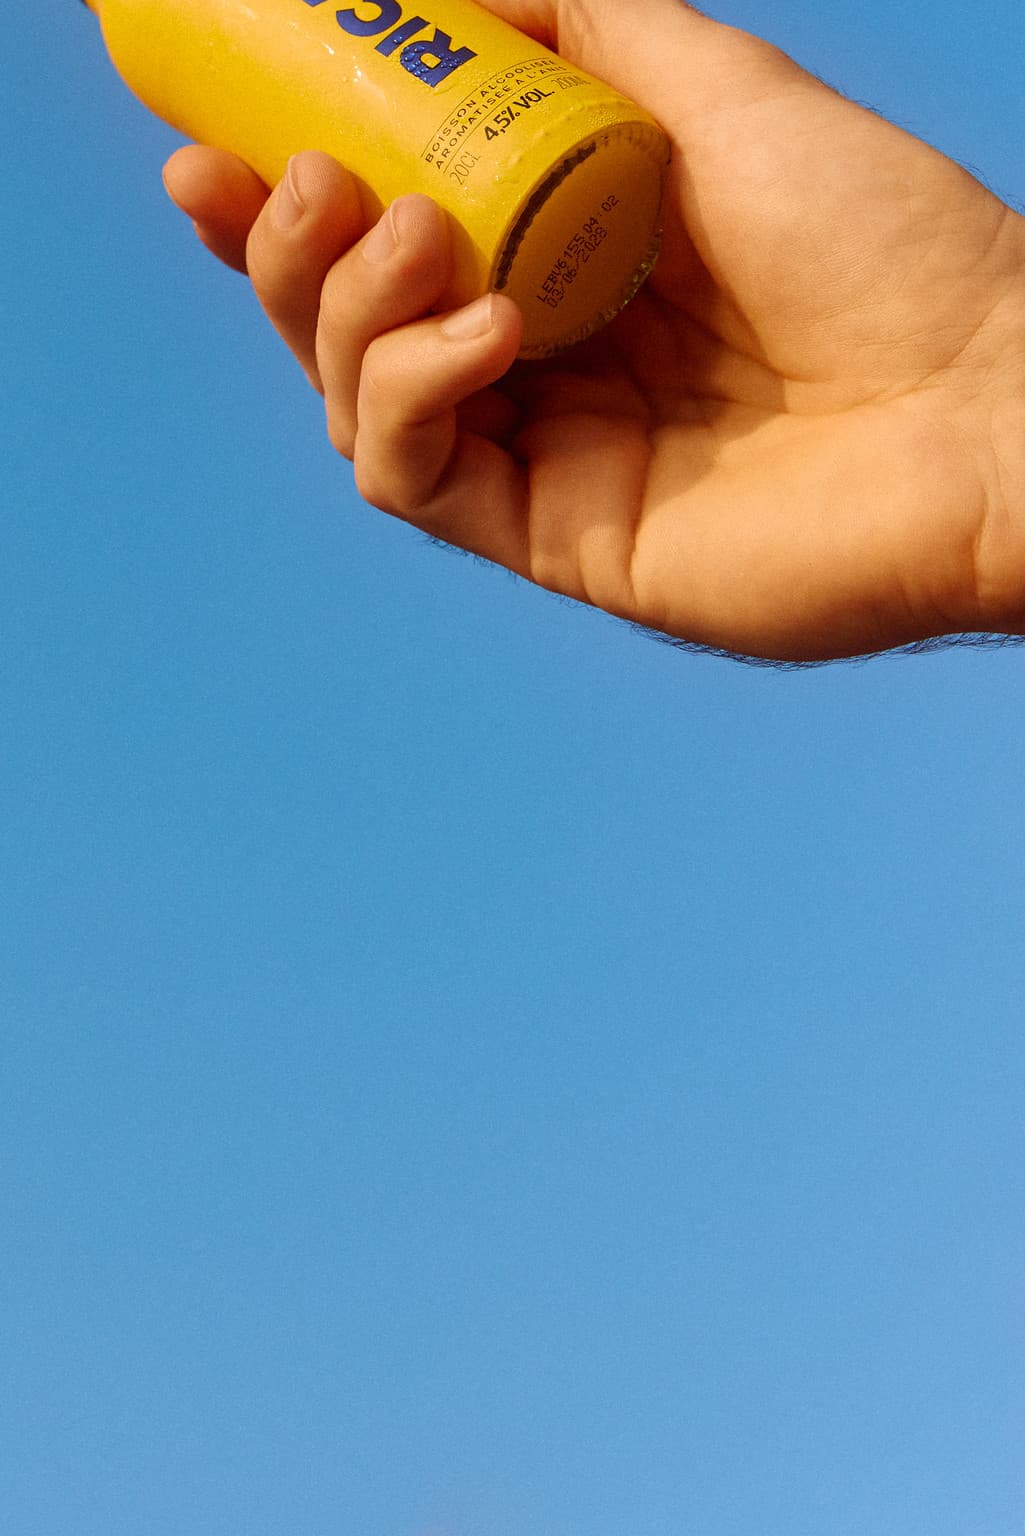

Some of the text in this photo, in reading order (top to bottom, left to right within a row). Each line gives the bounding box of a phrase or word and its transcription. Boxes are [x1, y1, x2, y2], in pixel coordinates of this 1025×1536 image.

[425, 100, 477, 163] BOISSON
[483, 87, 556, 142] 4,5% VOL.
[449, 151, 482, 185] 20CL
